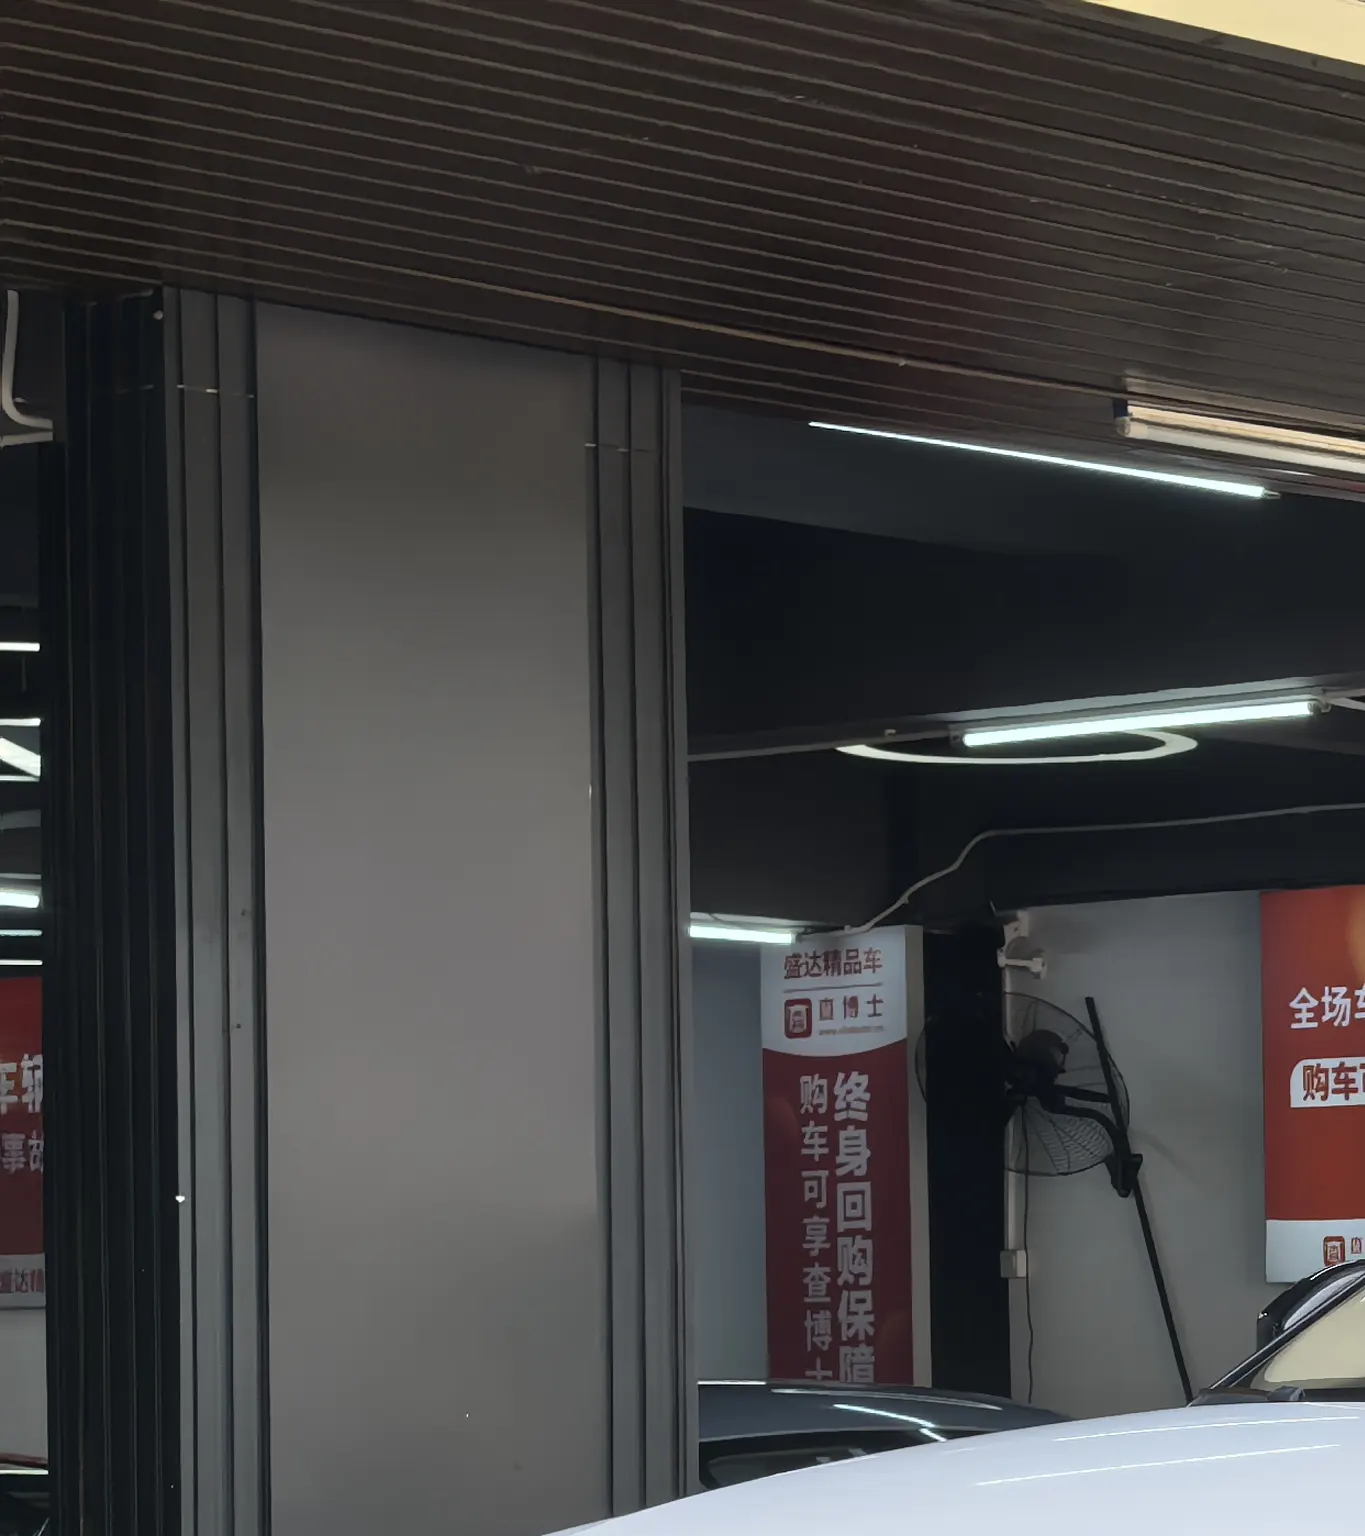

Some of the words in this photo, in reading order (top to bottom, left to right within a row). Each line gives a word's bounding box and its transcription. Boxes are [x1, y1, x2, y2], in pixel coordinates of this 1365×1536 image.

[784, 947, 883, 980] 盛达精品车
[800, 1074, 833, 1381] 购车可享查博士
[833, 1071, 876, 1383] 终身回购保障
